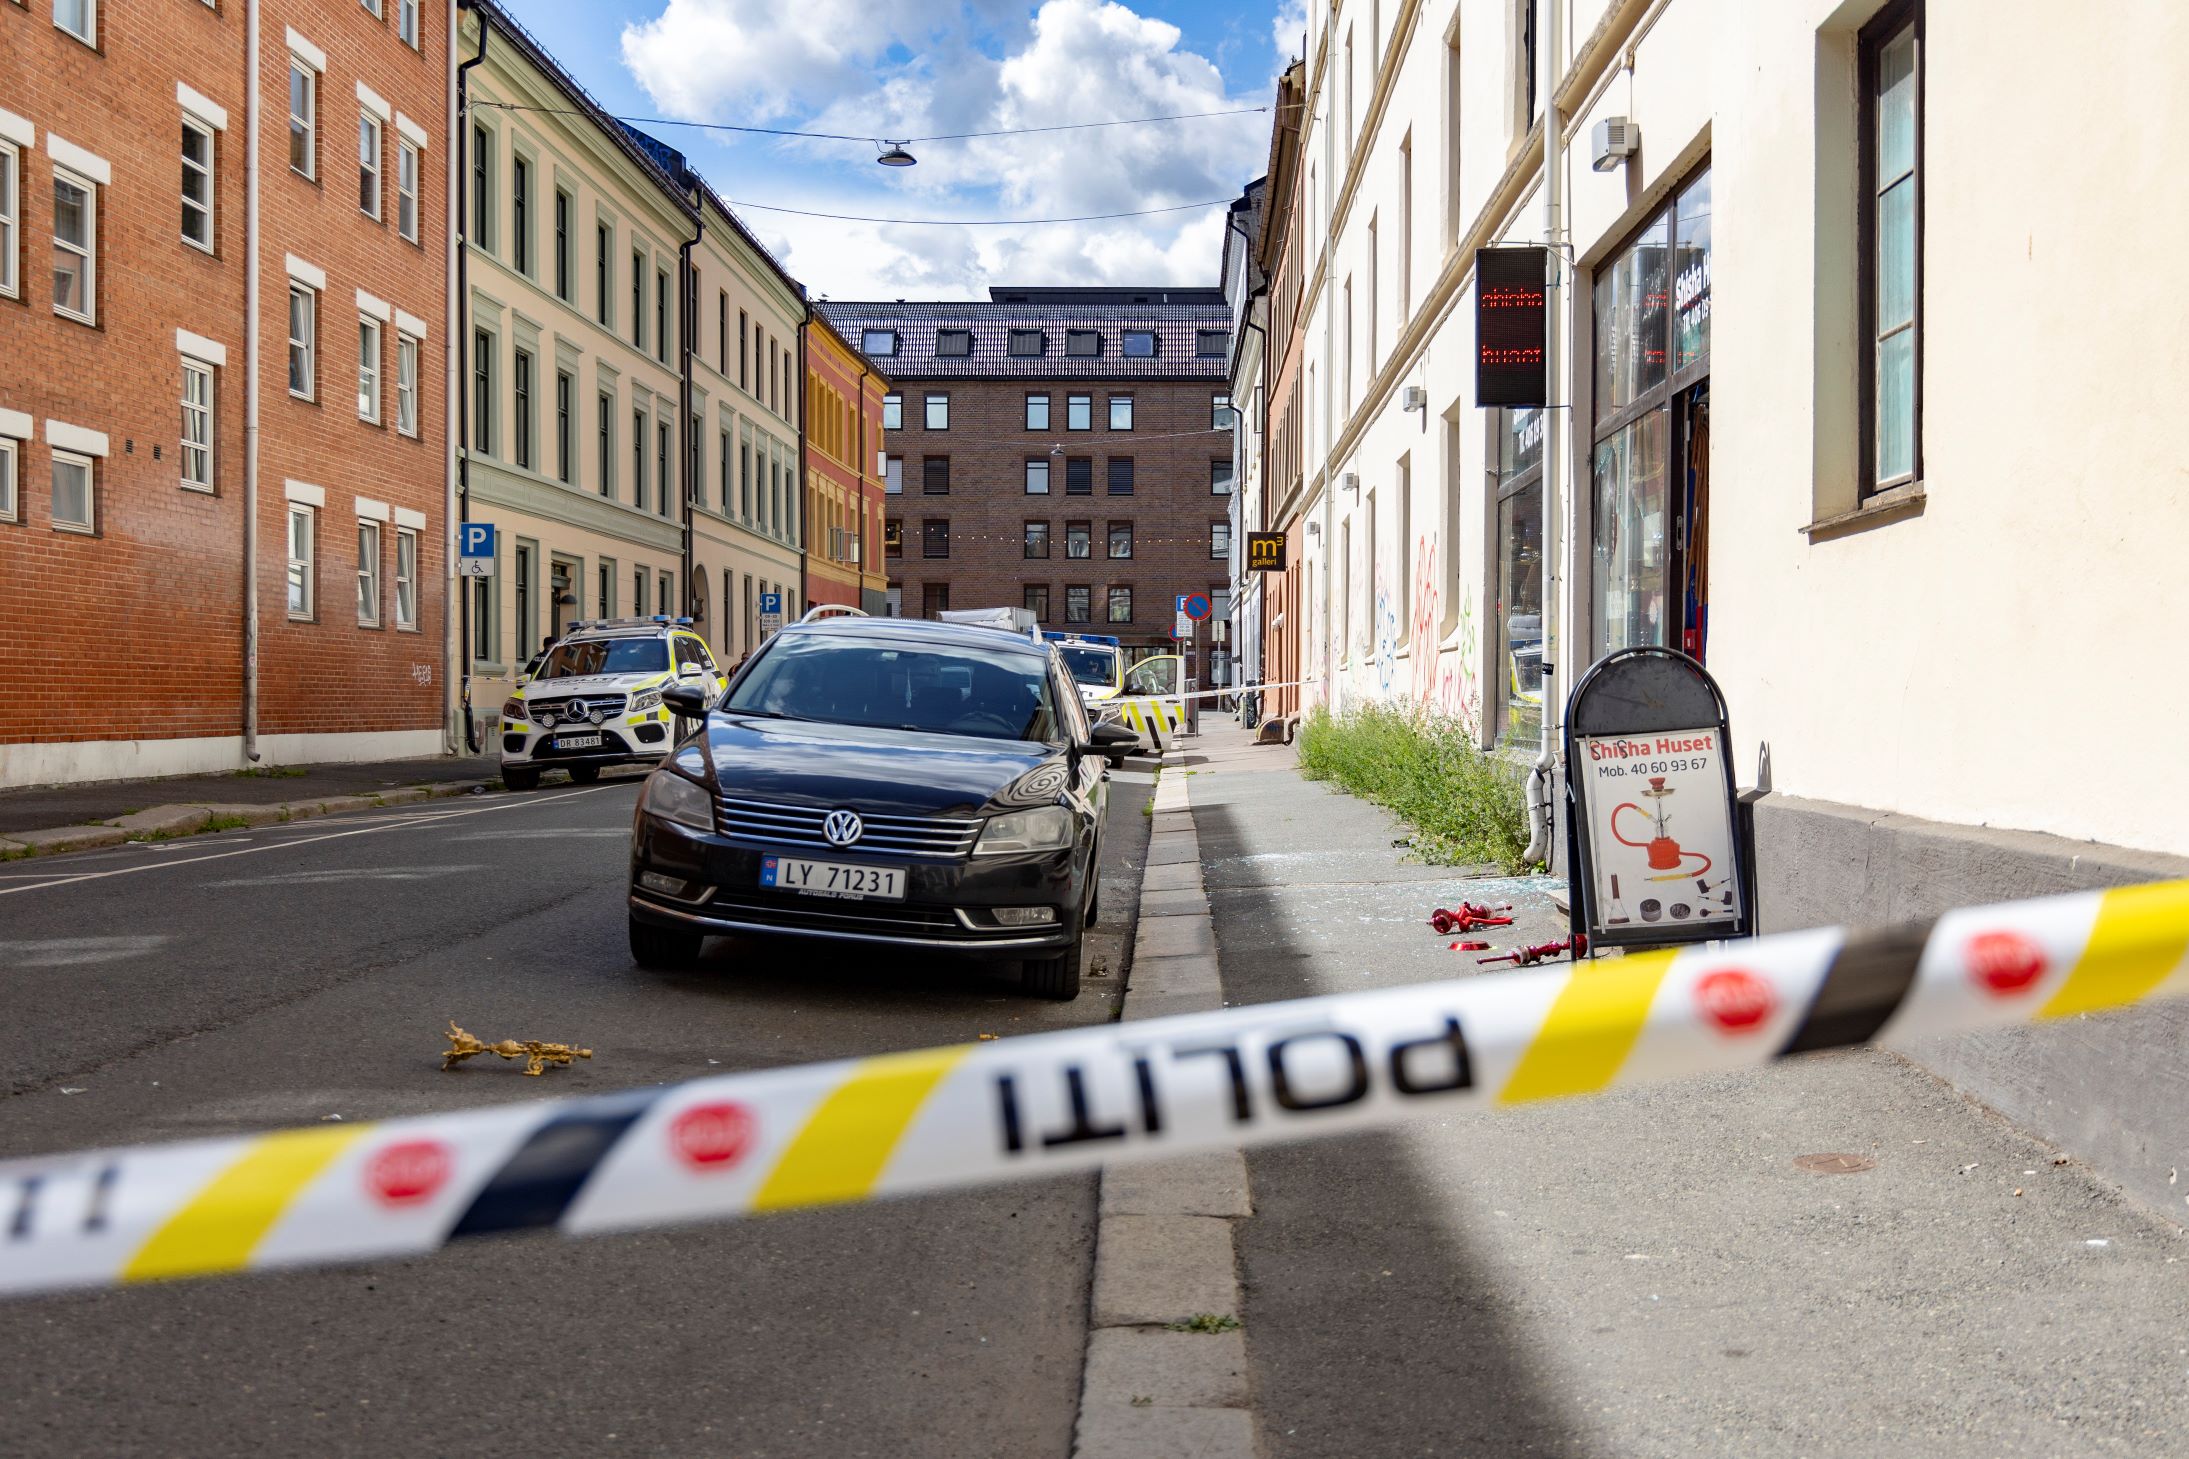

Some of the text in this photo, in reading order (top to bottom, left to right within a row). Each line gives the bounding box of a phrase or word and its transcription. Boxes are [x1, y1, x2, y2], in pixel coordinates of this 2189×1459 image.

[1675, 264, 1702, 311] Shisha
[1703, 252, 1712, 287] H
[468, 527, 487, 553] P
[1252, 558, 1277, 568] galleri
[765, 596, 777, 612] P
[560, 737, 600, 748] DR 83481
[1589, 735, 1713, 761] Shisha Huset
[1599, 757, 1708, 778] Mob. 40 60 93 67
[765, 873, 773, 881] N
[785, 862, 894, 895] LY 71231
[996, 1015, 1474, 1153] POLITI
